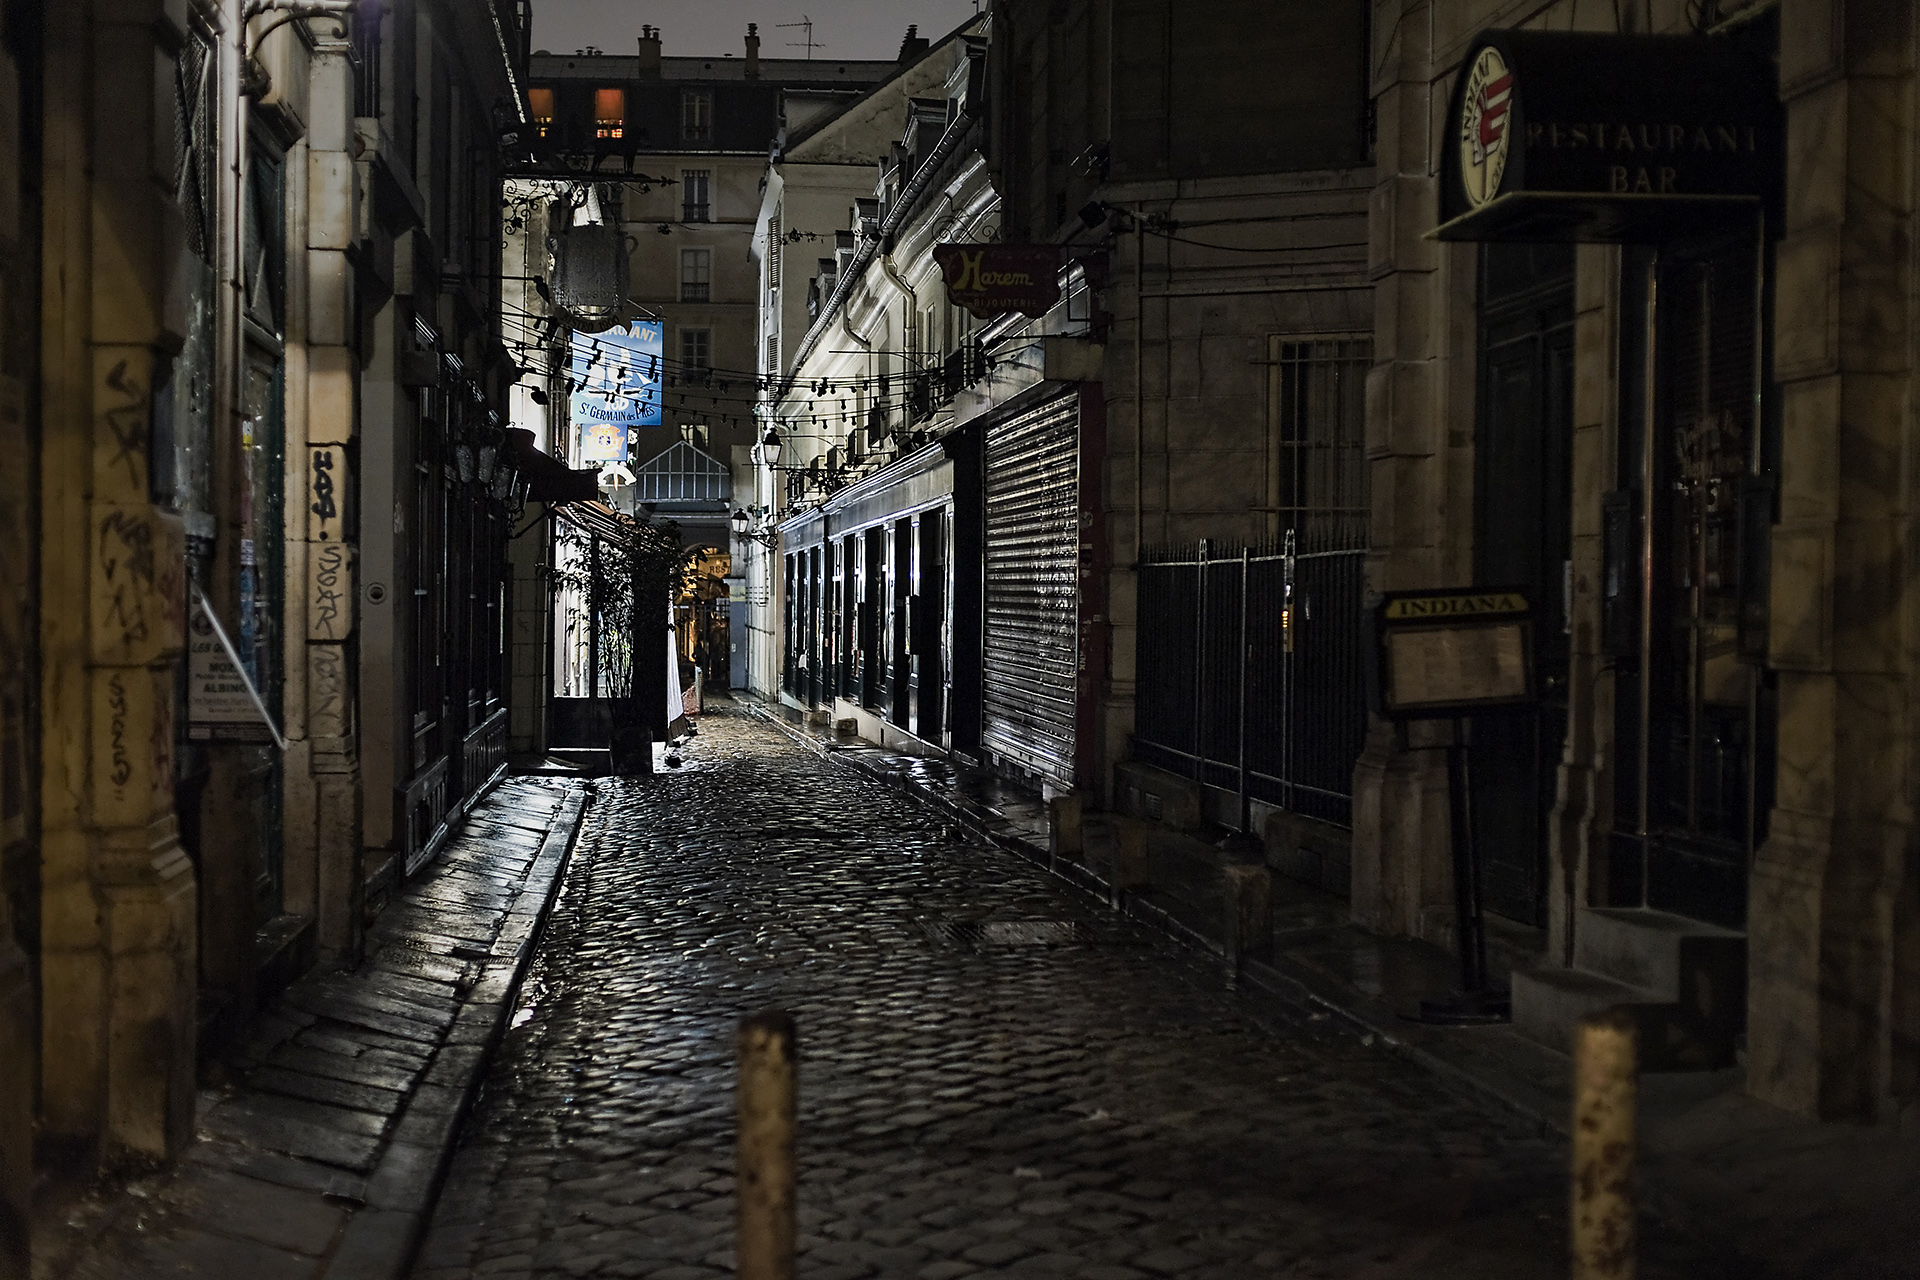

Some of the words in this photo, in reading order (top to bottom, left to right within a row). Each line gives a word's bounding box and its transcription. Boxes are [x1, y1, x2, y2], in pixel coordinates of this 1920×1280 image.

[1526, 122, 1756, 152] RESTAURANT
[1610, 165, 1678, 193] BAR
[952, 250, 1035, 292] Harem
[973, 298, 1037, 308] BIJOUTERIE
[598, 314, 620, 331] 1900
[589, 405, 626, 421] GERMAIN
[1400, 596, 1516, 616] INDIANA
